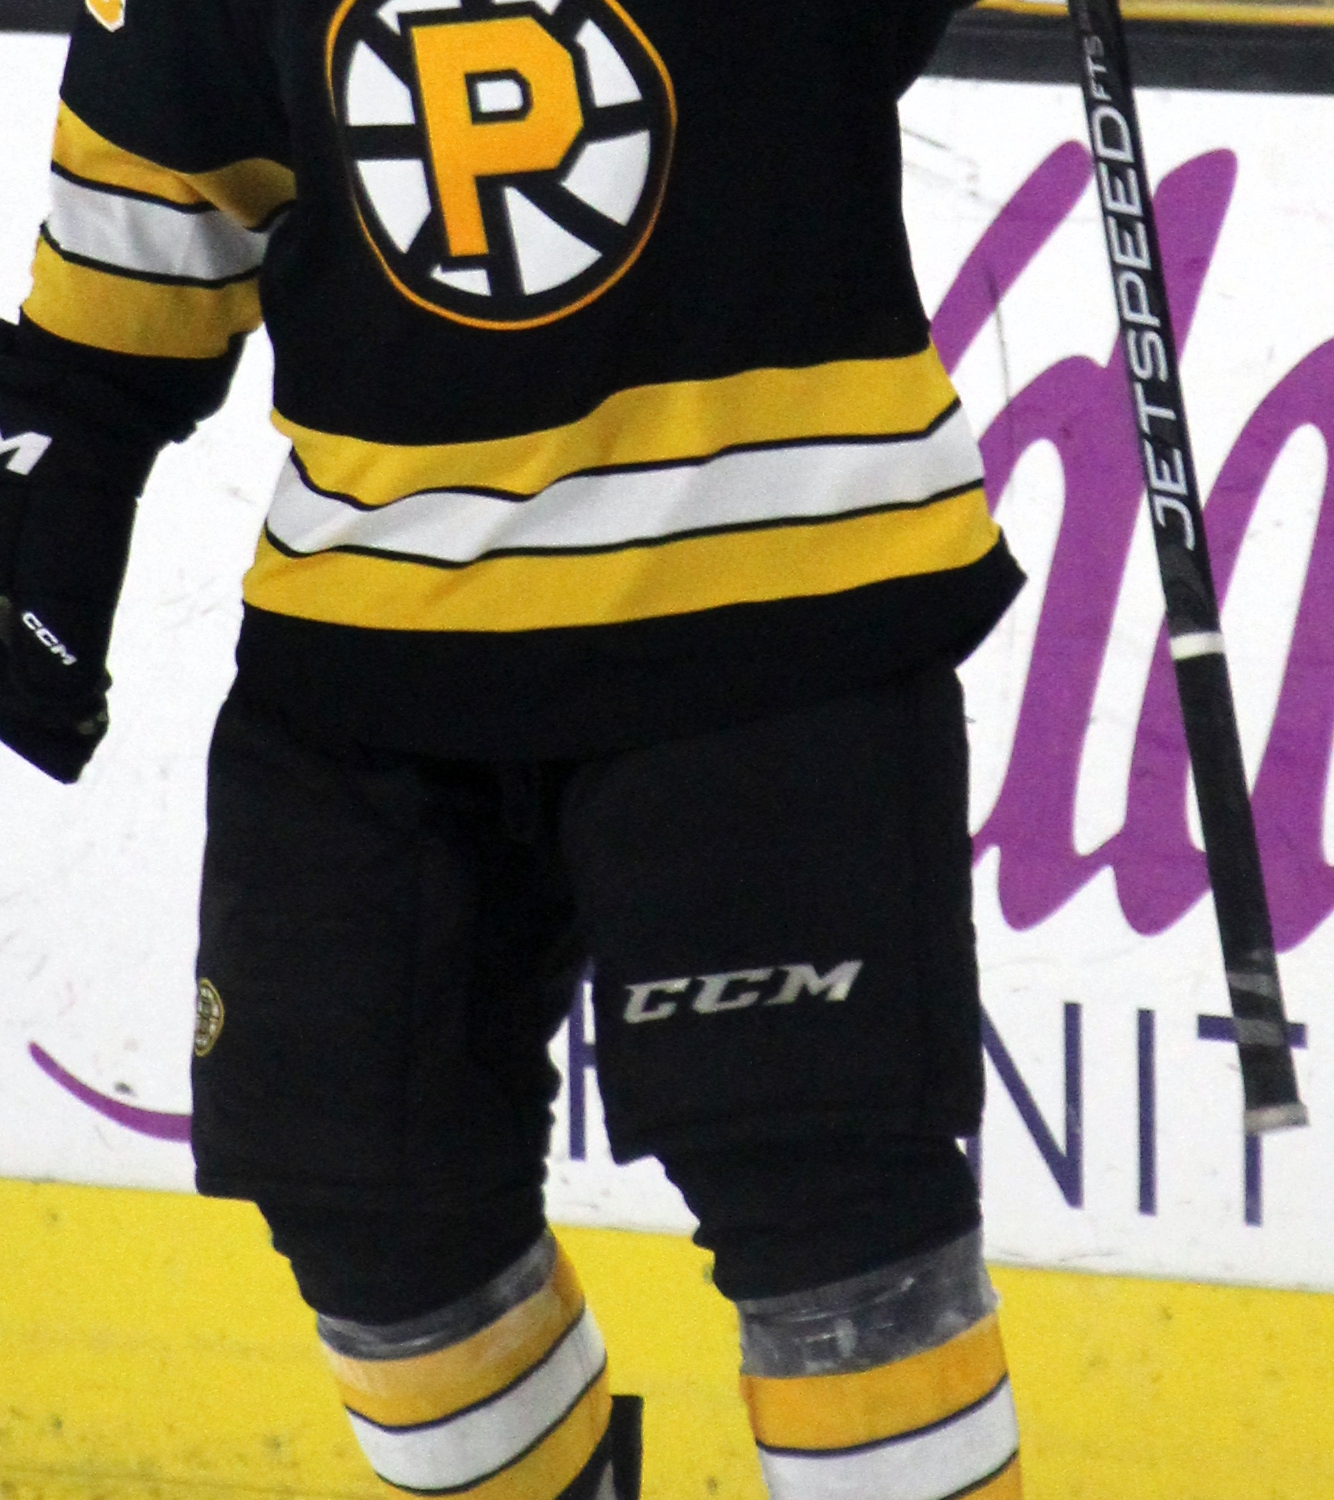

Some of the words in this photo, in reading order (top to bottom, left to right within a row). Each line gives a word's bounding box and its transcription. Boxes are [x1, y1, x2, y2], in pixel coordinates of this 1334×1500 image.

[408, 14, 585, 257] P
[1089, 105, 1196, 551] JETSPEED
[21, 610, 78, 667] CCM
[623, 958, 865, 1026] CCM
